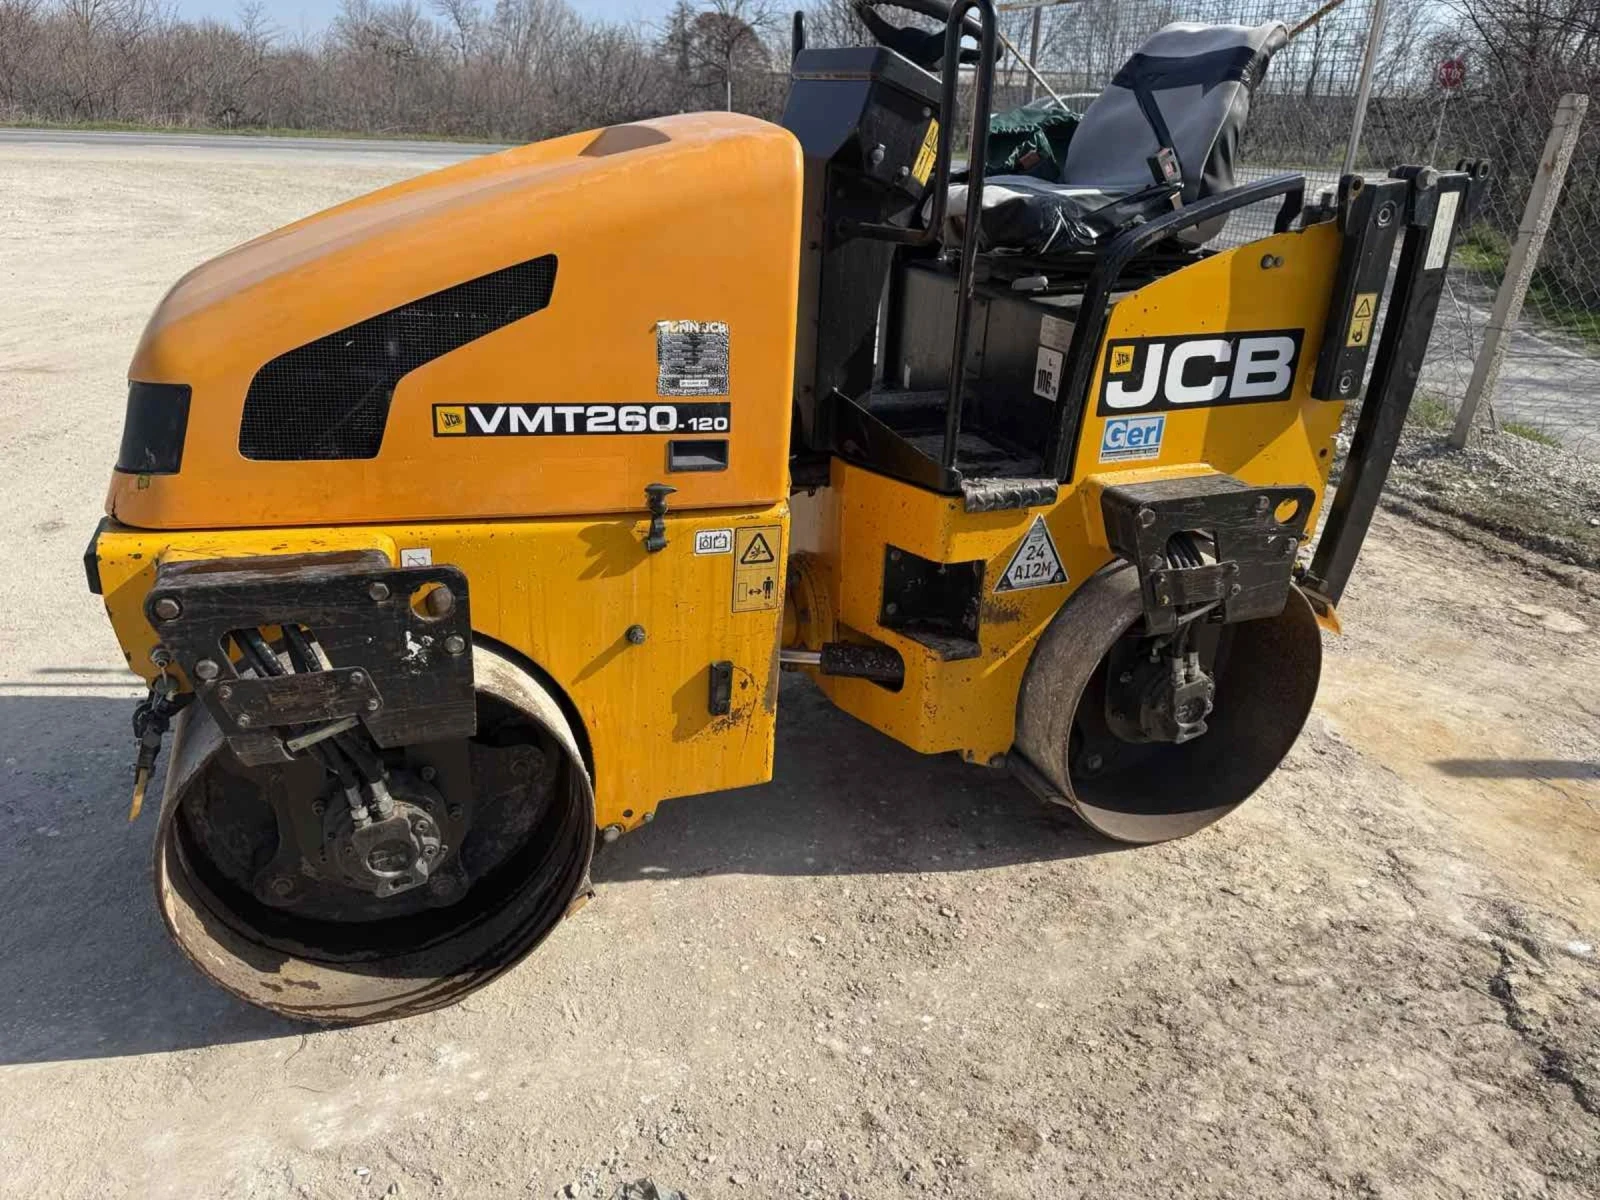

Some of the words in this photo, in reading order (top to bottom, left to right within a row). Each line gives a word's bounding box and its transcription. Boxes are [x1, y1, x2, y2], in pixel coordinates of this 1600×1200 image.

[1116, 351, 1130, 367] JCB
[1037, 369, 1053, 394] 106
[1105, 336, 1295, 409] JCB
[439, 411, 462, 429] JCB
[1105, 419, 1164, 448] Gerl
[1026, 543, 1045, 561] 24
